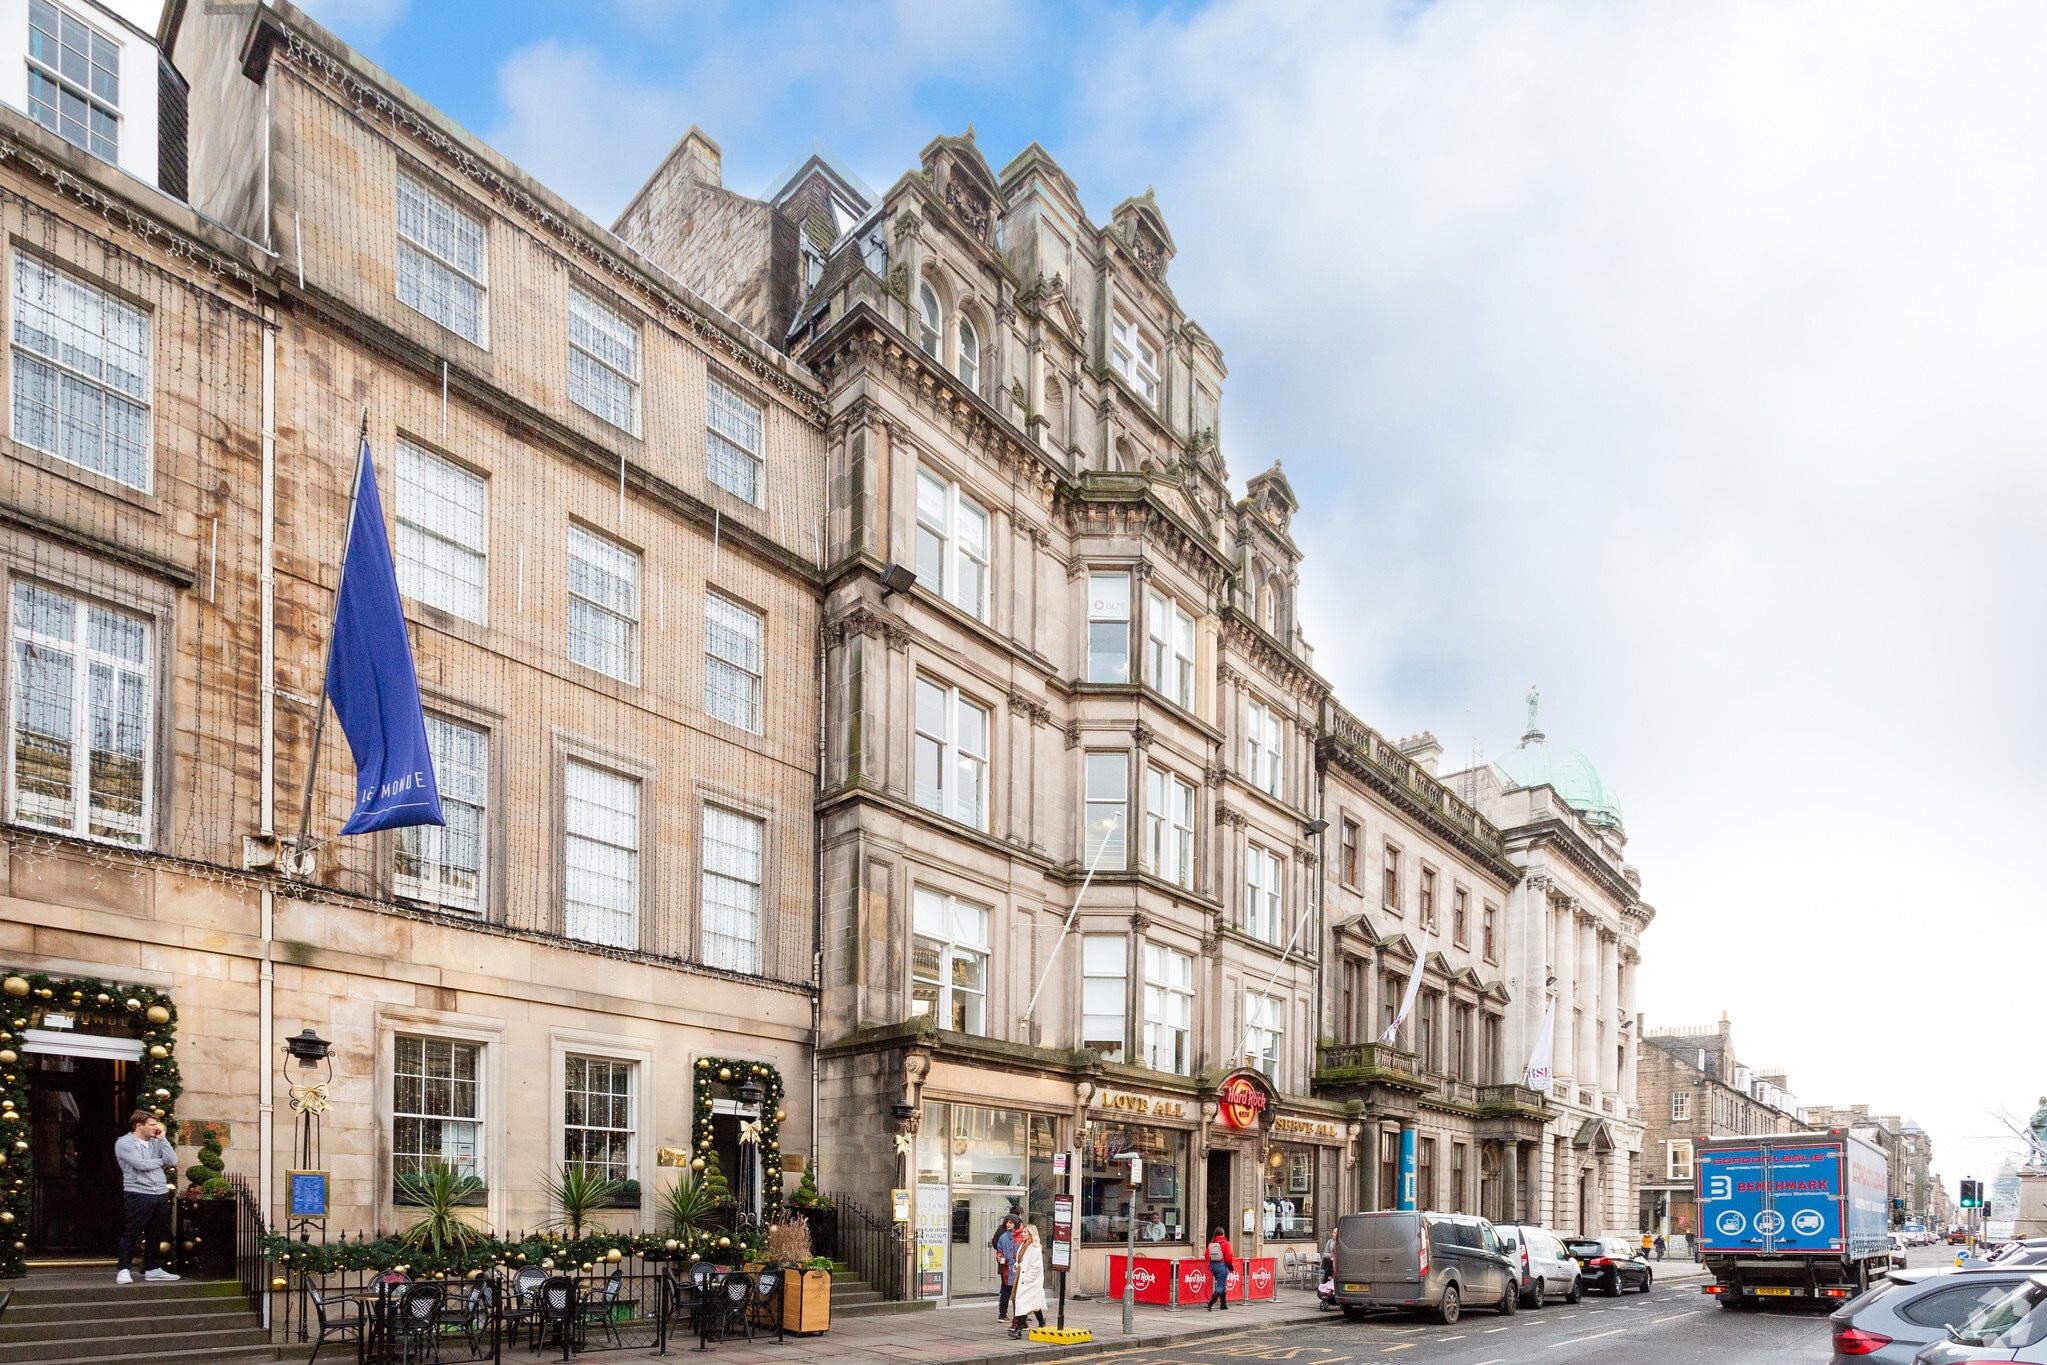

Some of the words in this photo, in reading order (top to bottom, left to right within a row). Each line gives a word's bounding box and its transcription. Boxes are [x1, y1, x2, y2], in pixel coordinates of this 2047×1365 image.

[1106, 601, 1124, 610] BLM
[381, 771, 426, 799] MONDE
[1102, 1091, 1149, 1112] LOVE
[1152, 1100, 1187, 1118] ALL
[1227, 1086, 1248, 1106] Hard
[1247, 1090, 1267, 1111] Rock
[1274, 1117, 1315, 1135] SERVE
[1314, 1123, 1338, 1137] ALL
[1774, 1153, 1825, 1163] LESLIE
[1737, 1180, 1830, 1192] BENCHMARK
[931, 1214, 948, 1227] LET
[1140, 1272, 1156, 1283] Rock
[1184, 1274, 1197, 1283] Hard
[1189, 1343, 1333, 1360] BUS
